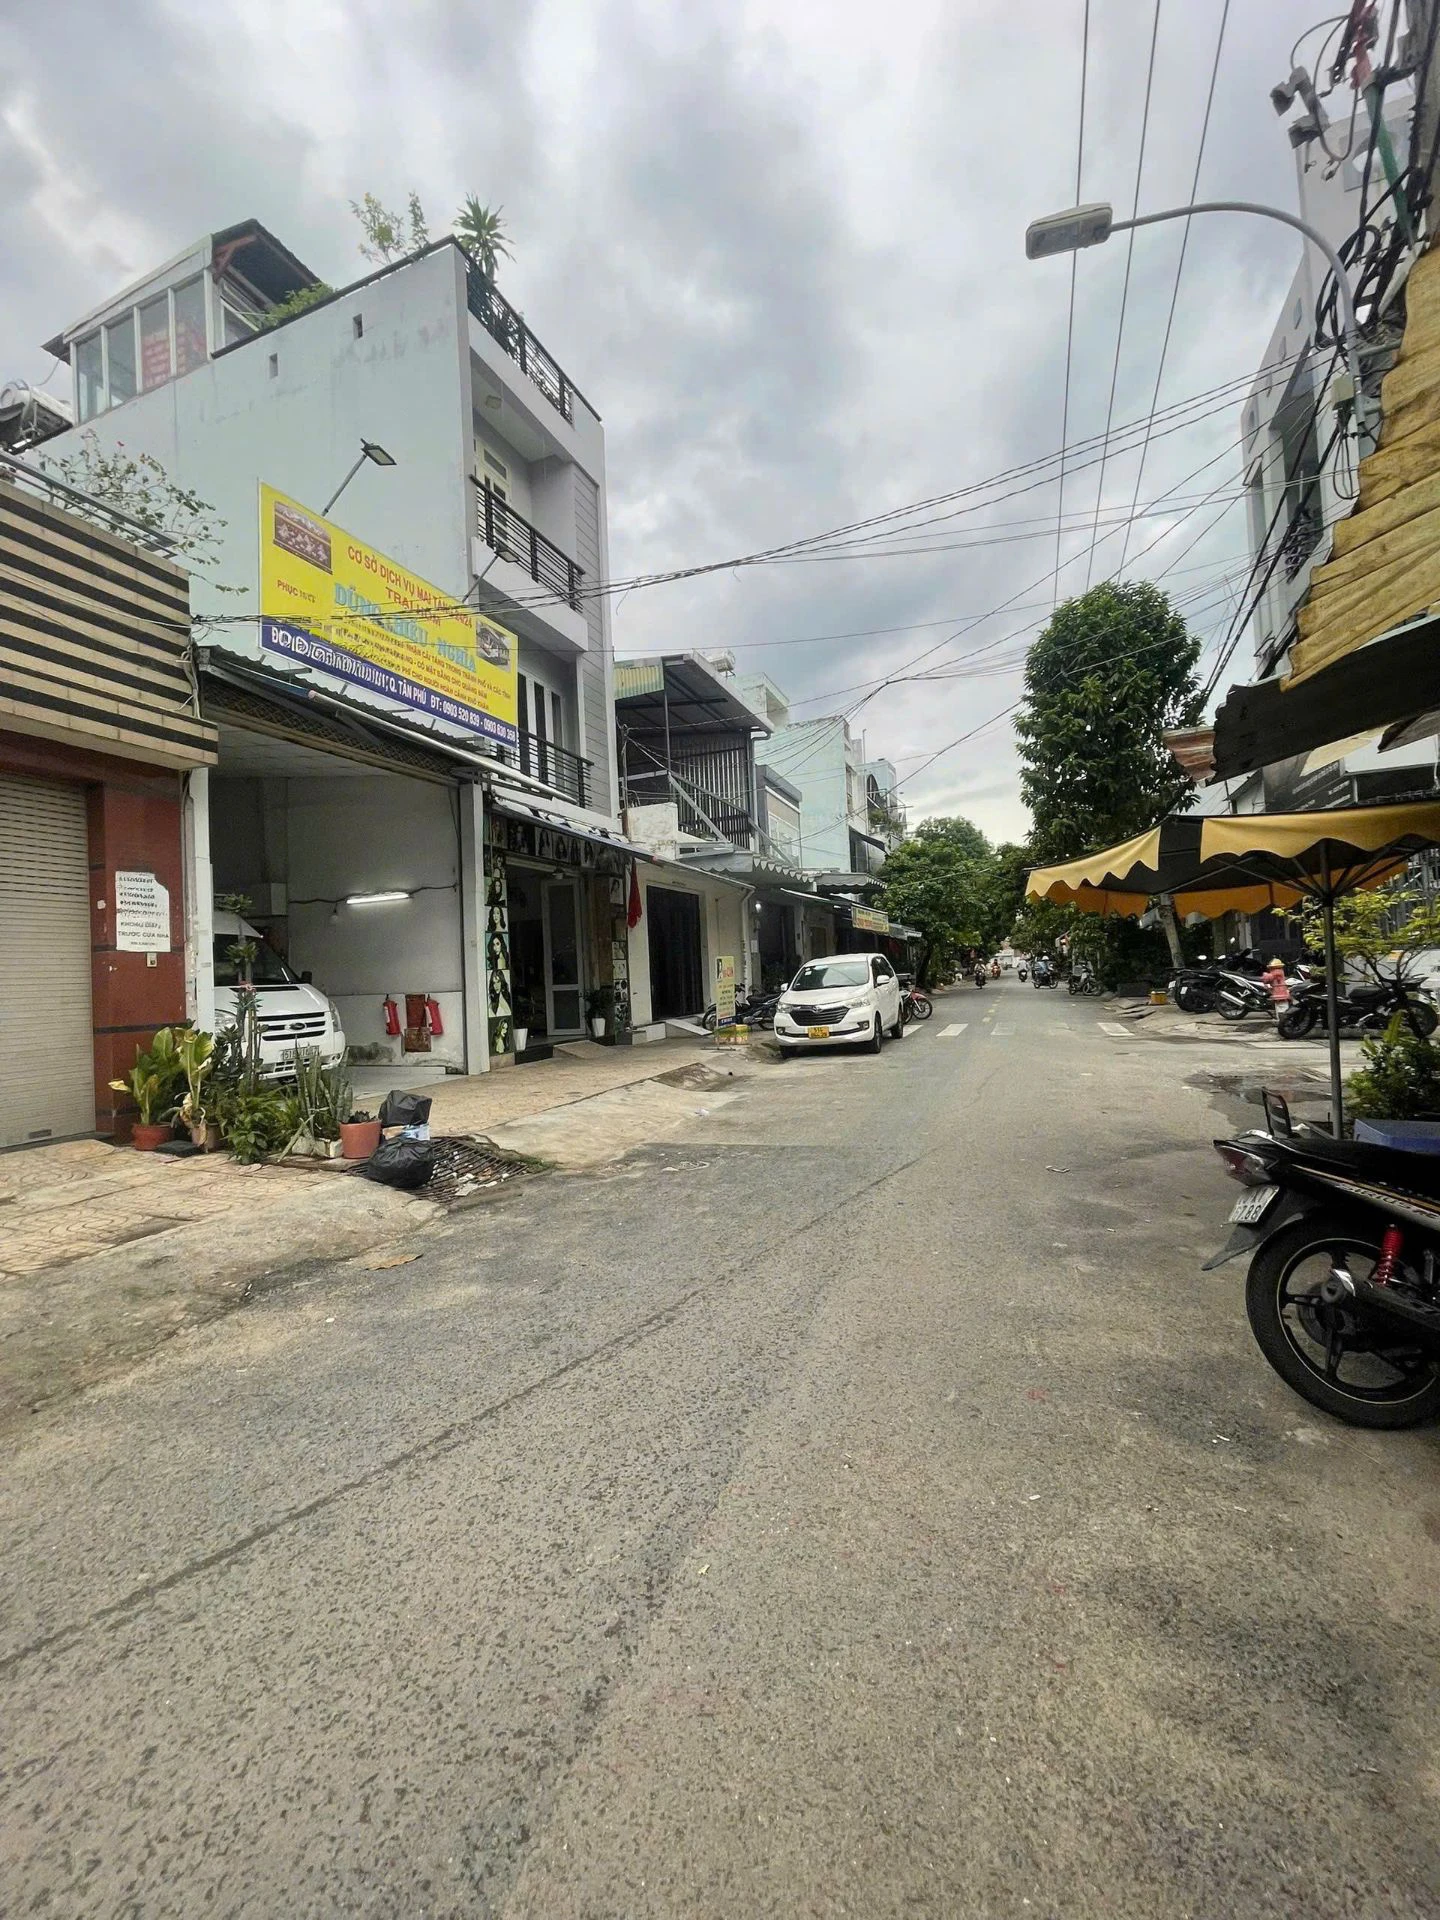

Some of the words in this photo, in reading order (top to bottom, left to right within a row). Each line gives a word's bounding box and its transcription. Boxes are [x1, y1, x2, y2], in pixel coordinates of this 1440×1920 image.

[348, 545, 362, 564] CƠ
[365, 554, 377, 573] SỞ
[380, 564, 401, 587] DỊCH
[403, 577, 415, 595] VỤ
[398, 679, 412, 699] TÂN
[413, 687, 427, 705] PHÚ
[442, 700, 457, 718] 0903
[458, 706, 468, 722] 520
[469, 712, 480, 727] 839
